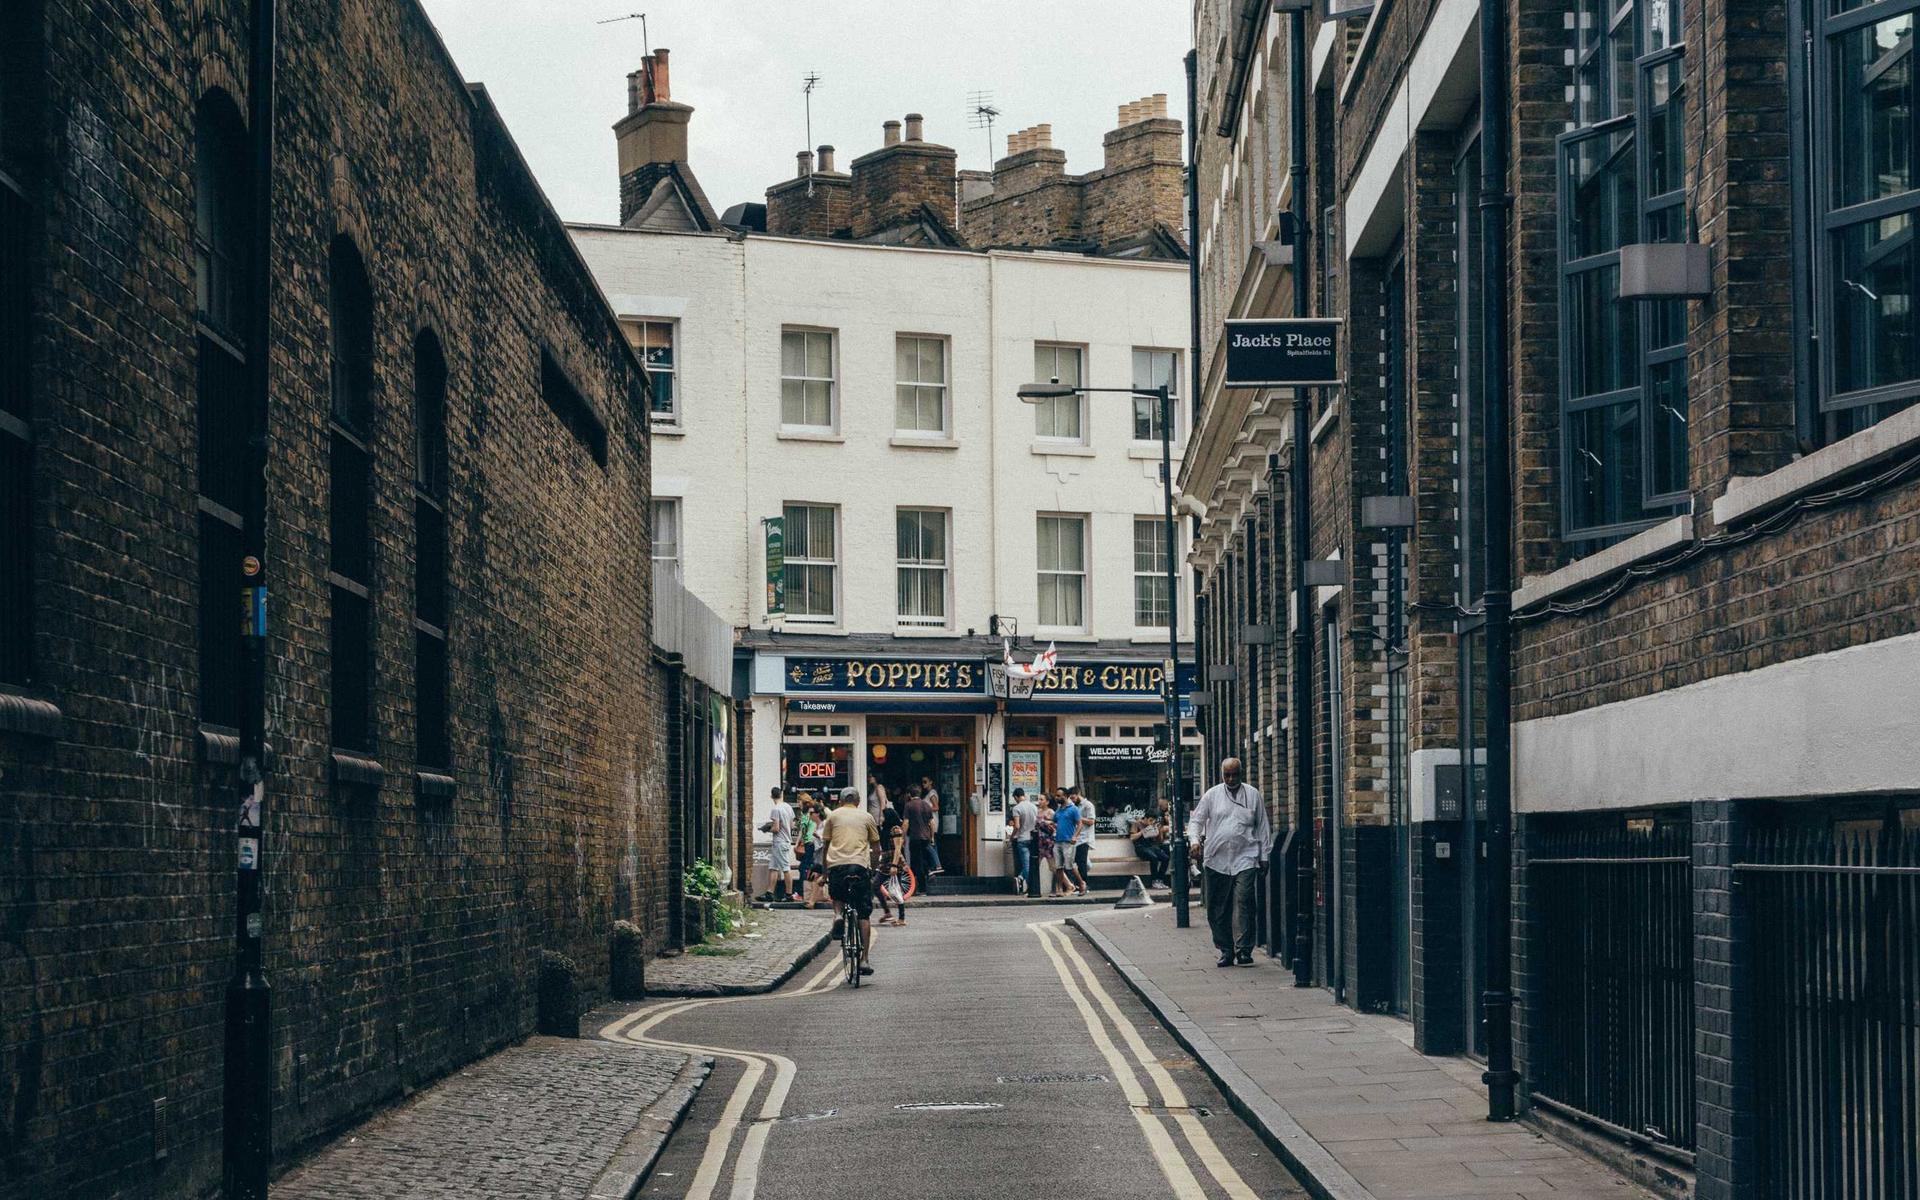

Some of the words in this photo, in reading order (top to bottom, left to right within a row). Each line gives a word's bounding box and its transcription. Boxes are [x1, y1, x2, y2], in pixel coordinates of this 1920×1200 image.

[1232, 333, 1281, 347] Jack's
[1286, 333, 1331, 347] Place
[1286, 349, 1322, 357] Spitalfields
[847, 661, 972, 689] POPPIE'S
[1083, 669, 1096, 686] &
[1099, 665, 1164, 691] CHIP
[1012, 685, 1029, 695] CHIPS
[799, 701, 836, 712] Takeaway
[1090, 747, 1129, 756] WELCOME
[1131, 747, 1142, 756] TO
[800, 763, 834, 777] OPEN
